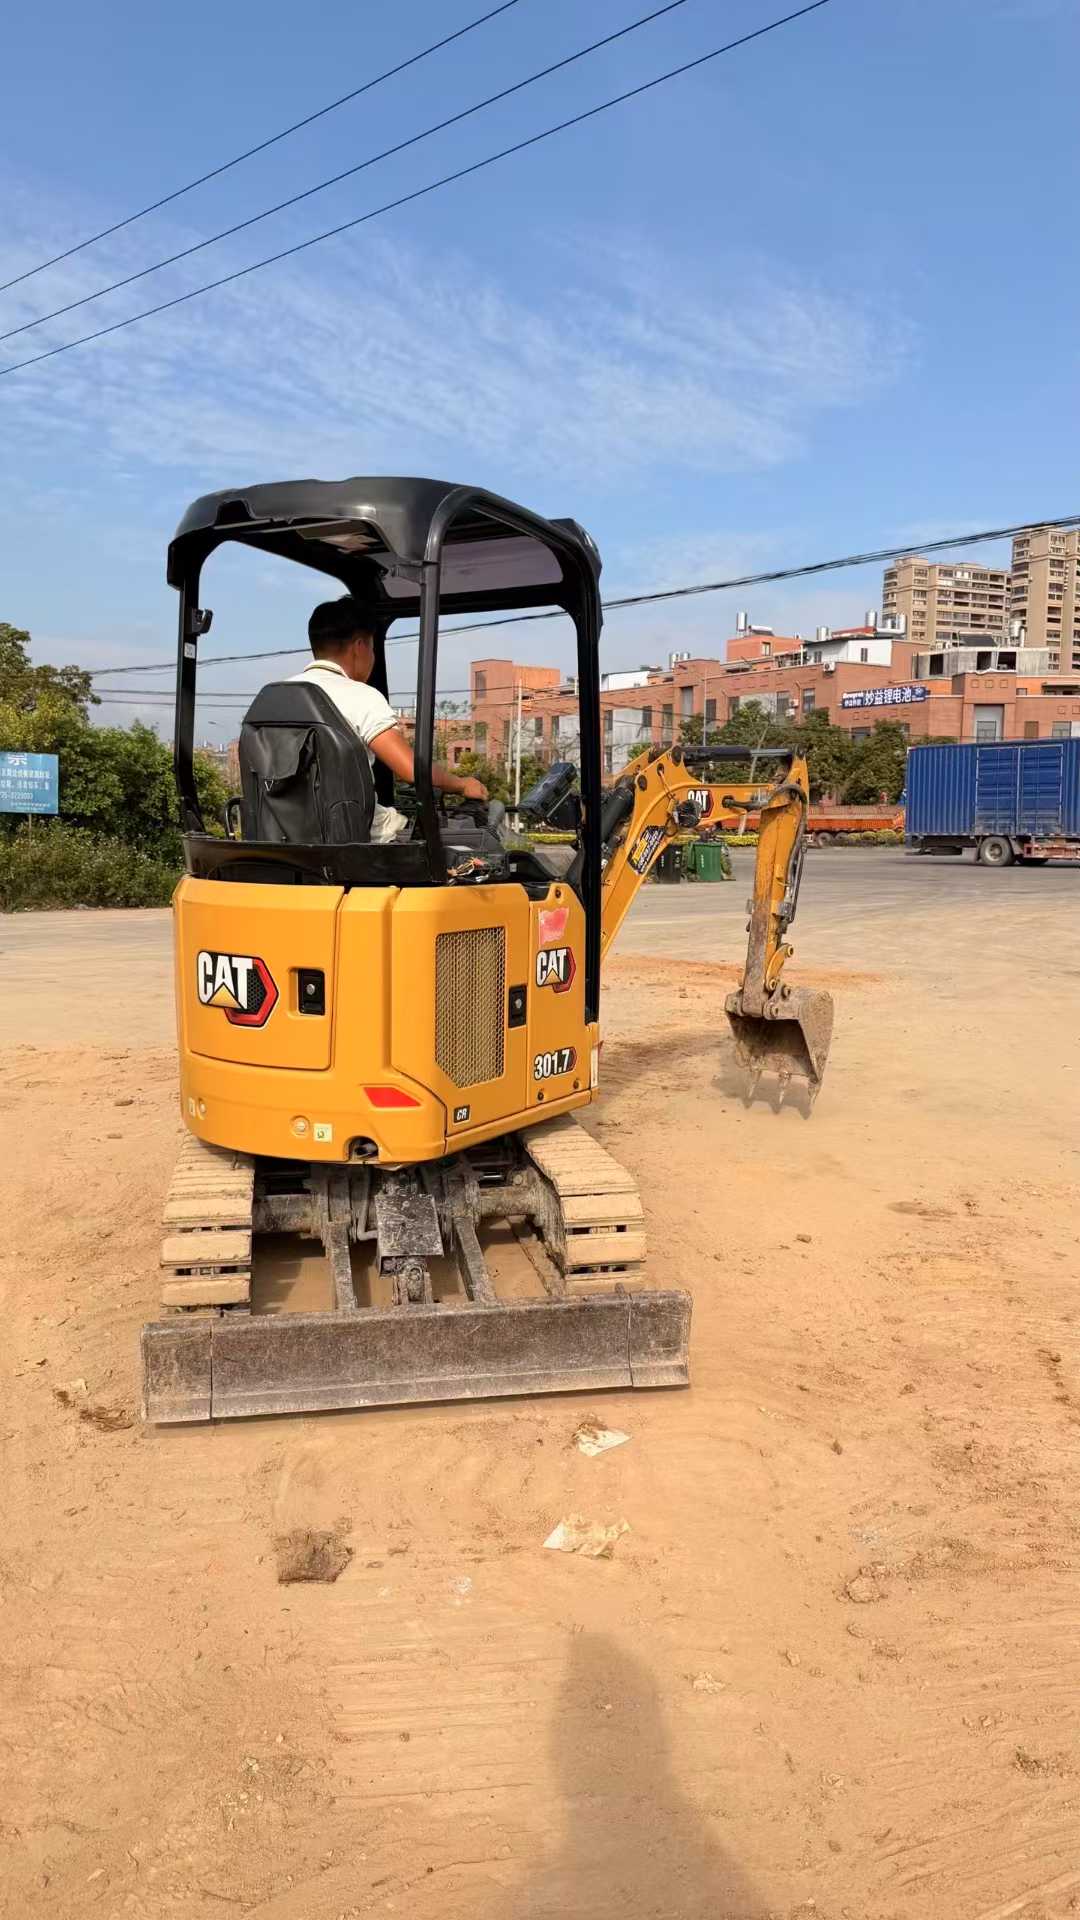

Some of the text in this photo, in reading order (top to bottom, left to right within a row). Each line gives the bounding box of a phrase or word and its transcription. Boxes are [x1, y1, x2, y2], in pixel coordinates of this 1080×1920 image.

[864, 687, 912, 706] 妙益锂电池
[198, 951, 254, 1010] CAT
[536, 948, 568, 987] CAT
[534, 1048, 571, 1080] 301.7
[456, 1107, 468, 1121] CR
